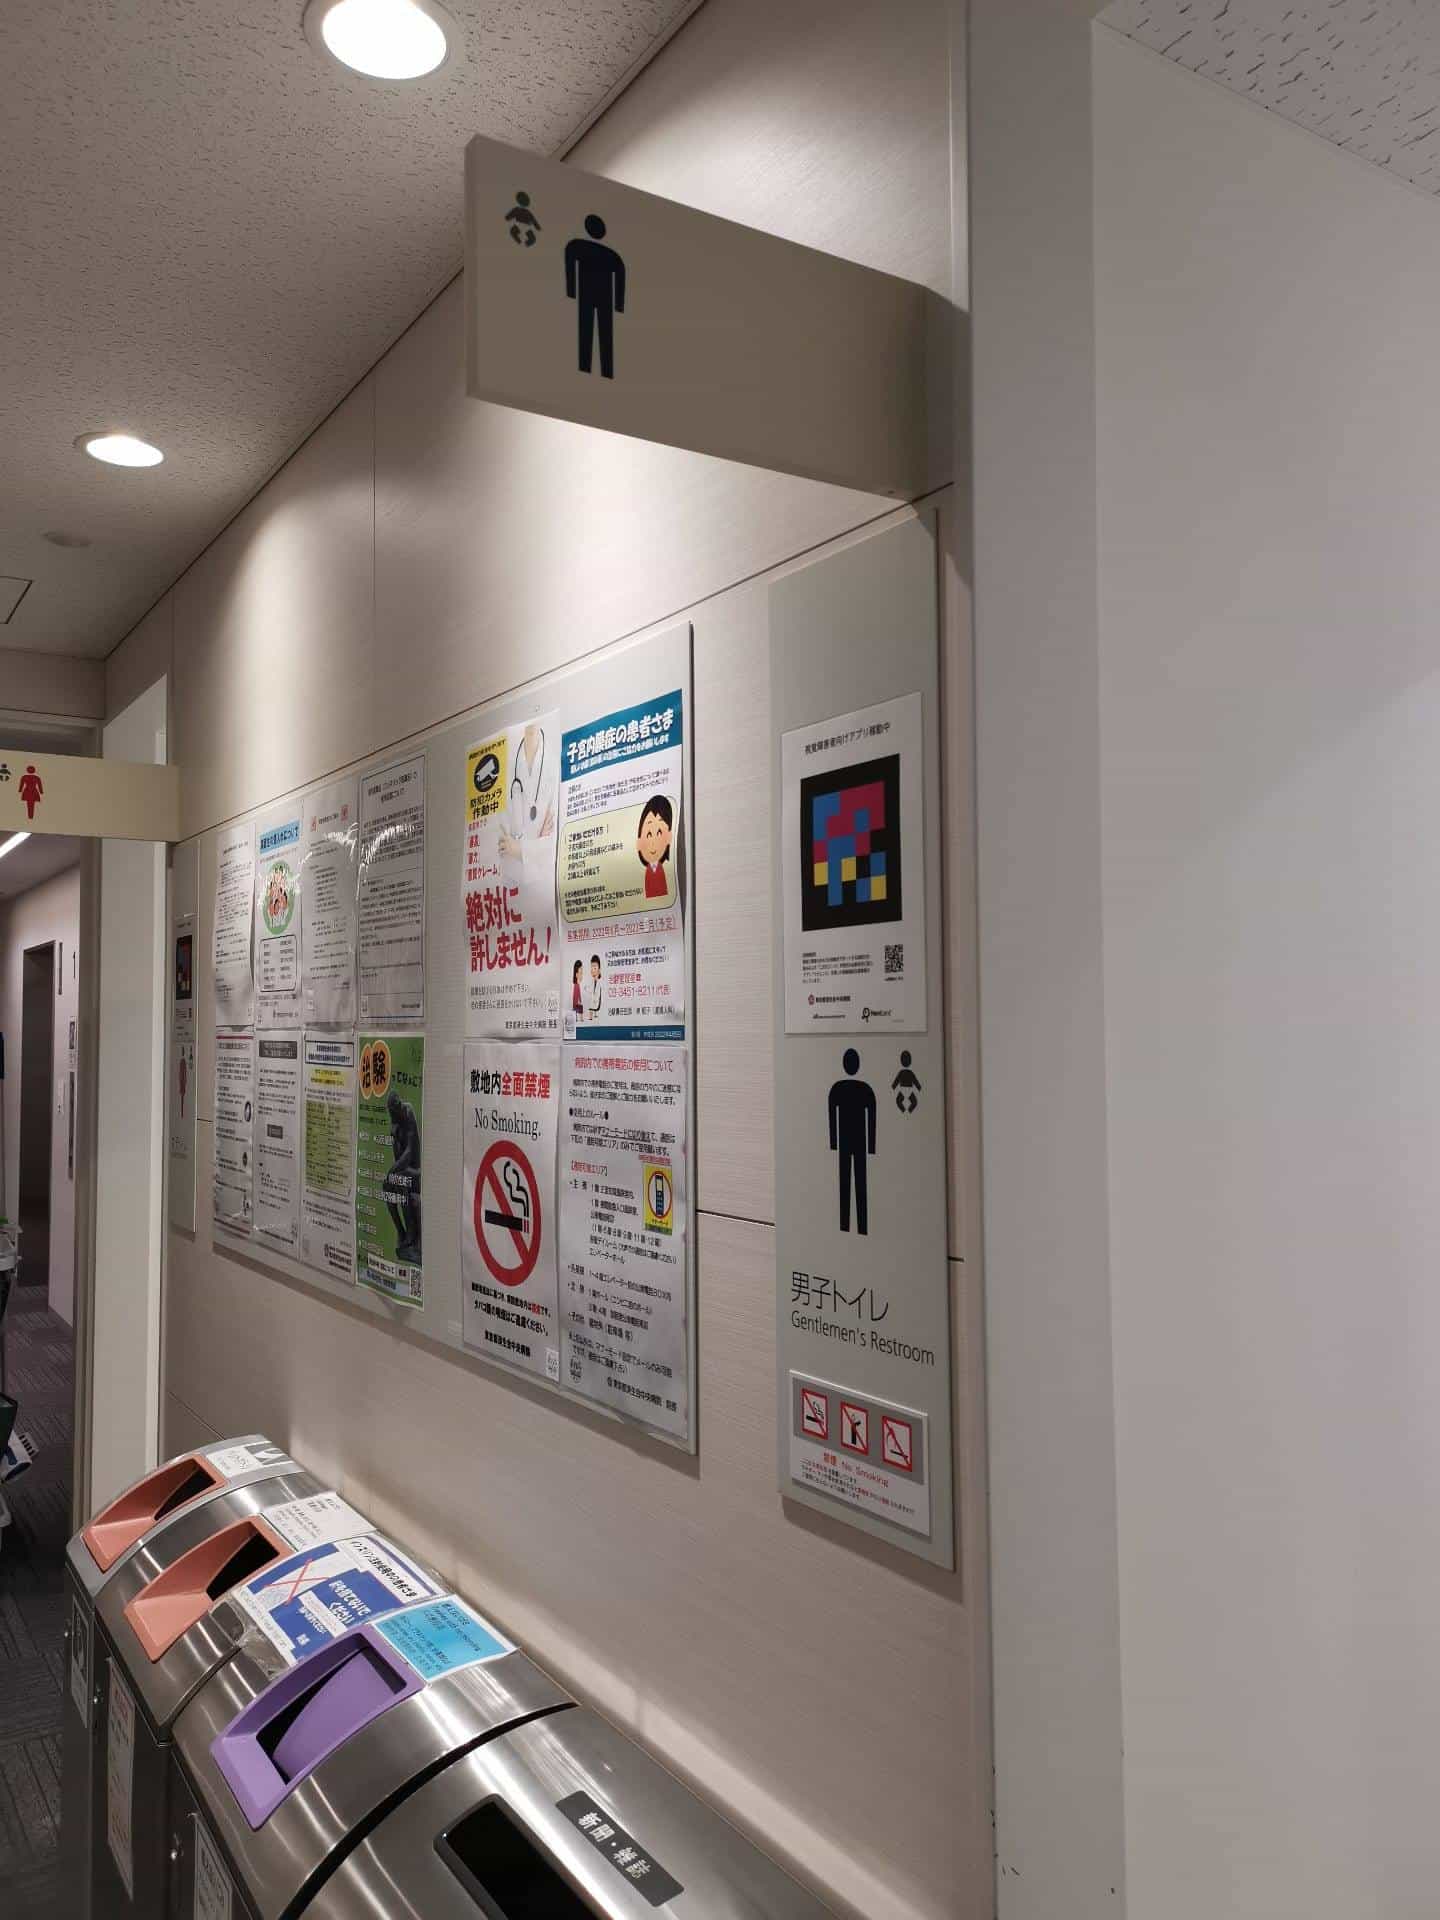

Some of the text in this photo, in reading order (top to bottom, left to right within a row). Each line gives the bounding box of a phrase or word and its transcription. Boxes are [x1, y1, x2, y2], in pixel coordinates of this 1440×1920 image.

[567, 708, 674, 763] 子宮内膜症の患者さま
[472, 801, 499, 820] 作動中
[465, 885, 522, 933] 絶対に
[469, 926, 551, 973] 許しません!
[470, 1068, 551, 1099] 敷地内全面禁煙
[474, 1107, 542, 1141] No Smoking.
[791, 1271, 889, 1322] 男子トイレ
[791, 1310, 935, 1367] Gentlemen's Restroom
[856, 1463, 889, 1489] Smoking
[578, 1811, 652, 1879] 新聞・雑誌
